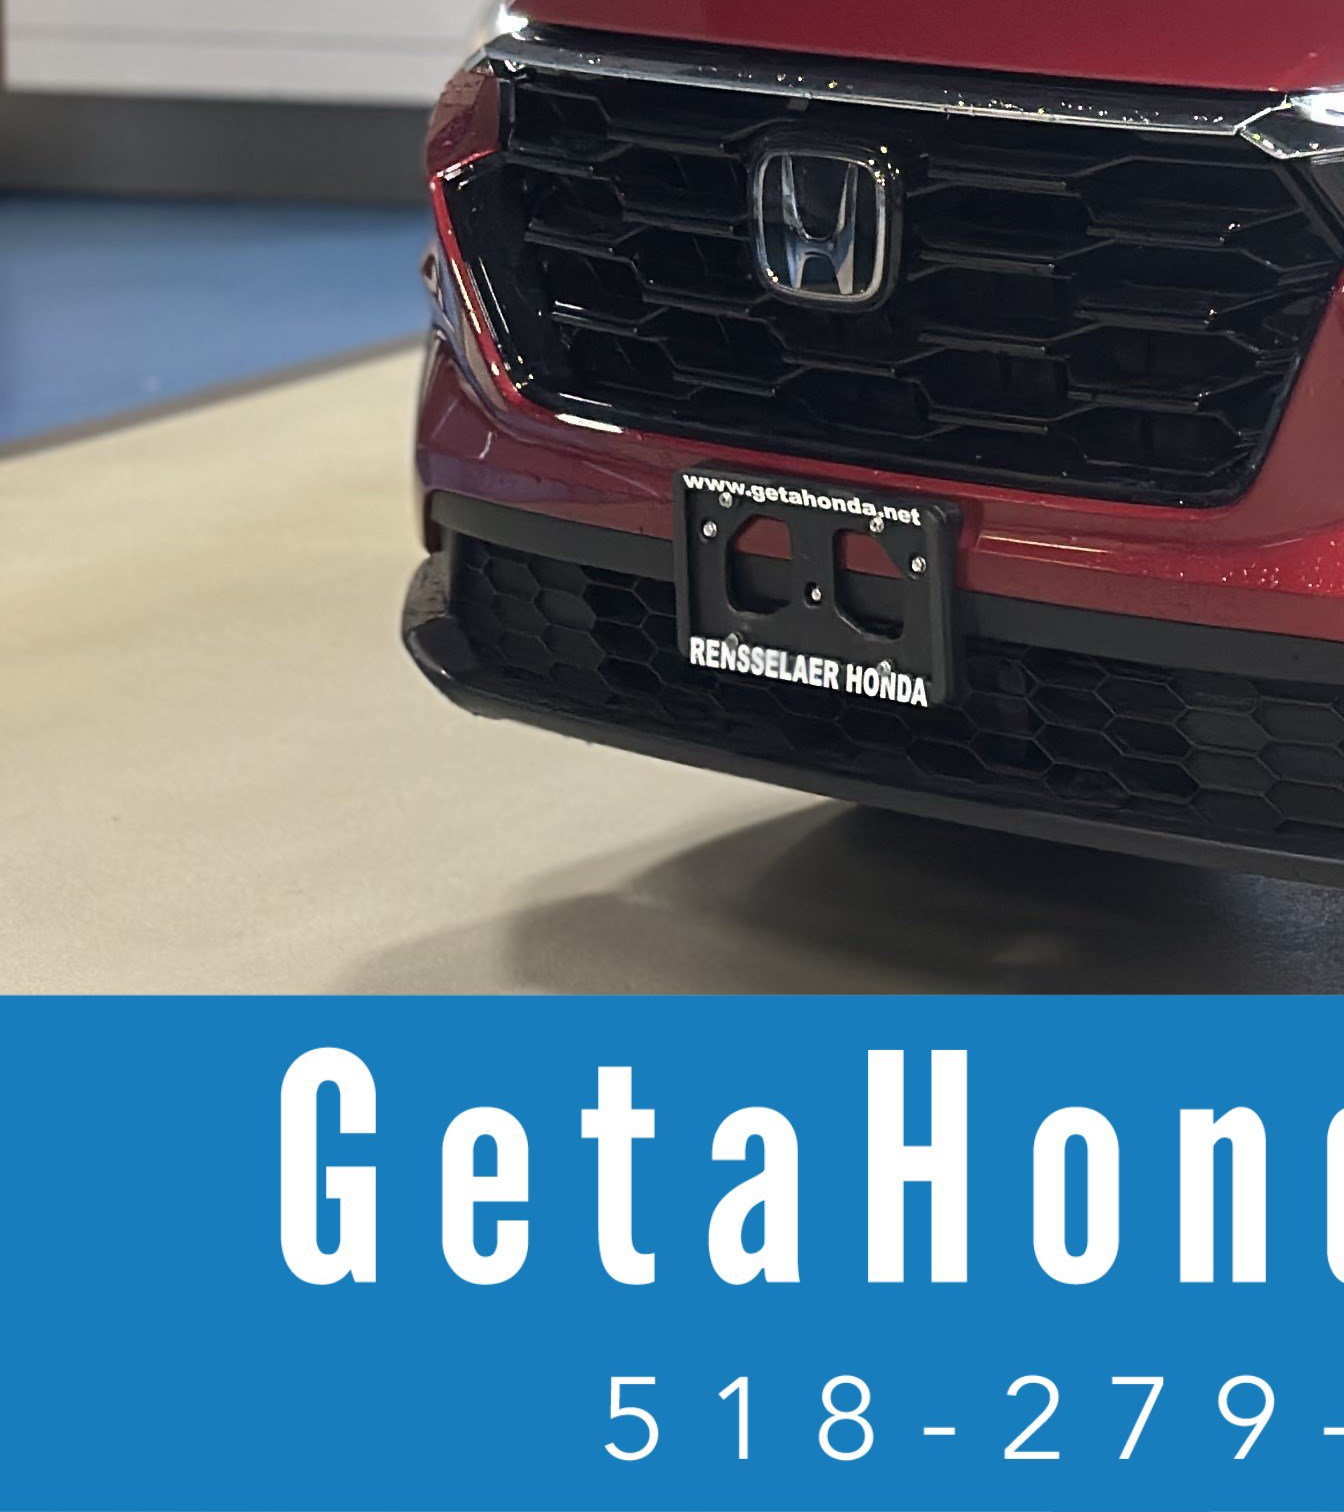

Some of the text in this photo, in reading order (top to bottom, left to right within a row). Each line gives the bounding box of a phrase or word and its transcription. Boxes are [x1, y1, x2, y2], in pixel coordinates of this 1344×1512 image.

[682, 473, 922, 527] www.getahonda.net
[690, 636, 929, 708] RENSSELAER HONDA
